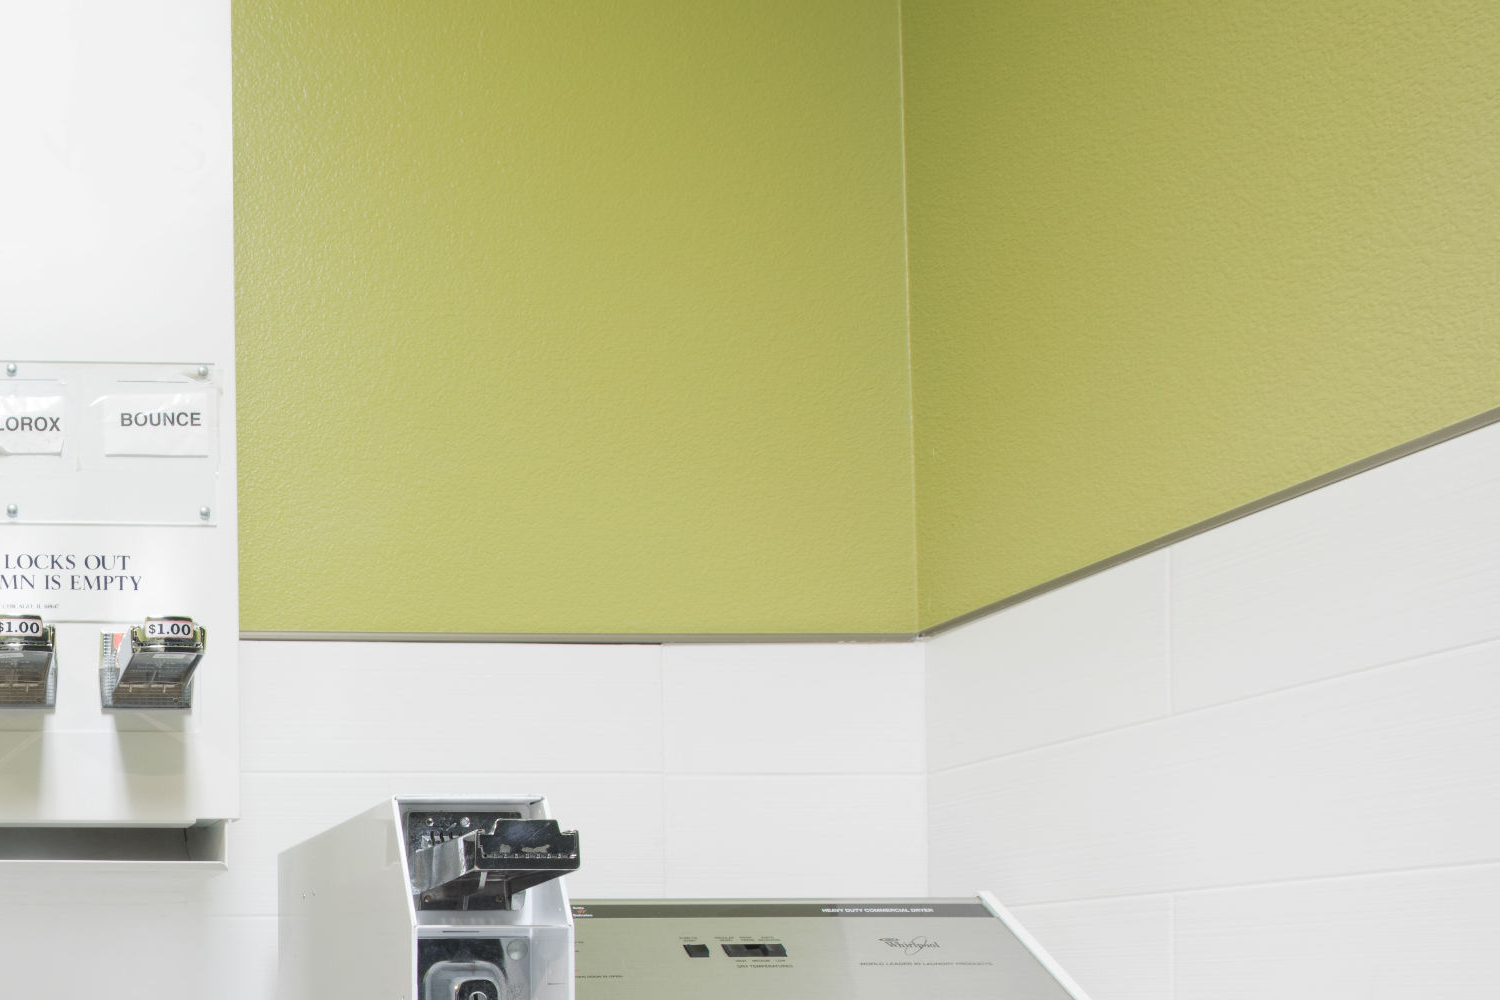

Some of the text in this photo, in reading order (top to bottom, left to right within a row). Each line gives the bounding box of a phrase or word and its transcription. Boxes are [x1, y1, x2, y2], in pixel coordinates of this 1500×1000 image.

[120, 412, 202, 428] BOUNCE
[5, 554, 76, 570] LOCKS
[84, 554, 131, 571] OUT
[45, 574, 62, 590] IS
[70, 575, 143, 591] EMPTY
[148, 622, 191, 636] $1.00
[884, 939, 940, 952] Whirlpool
